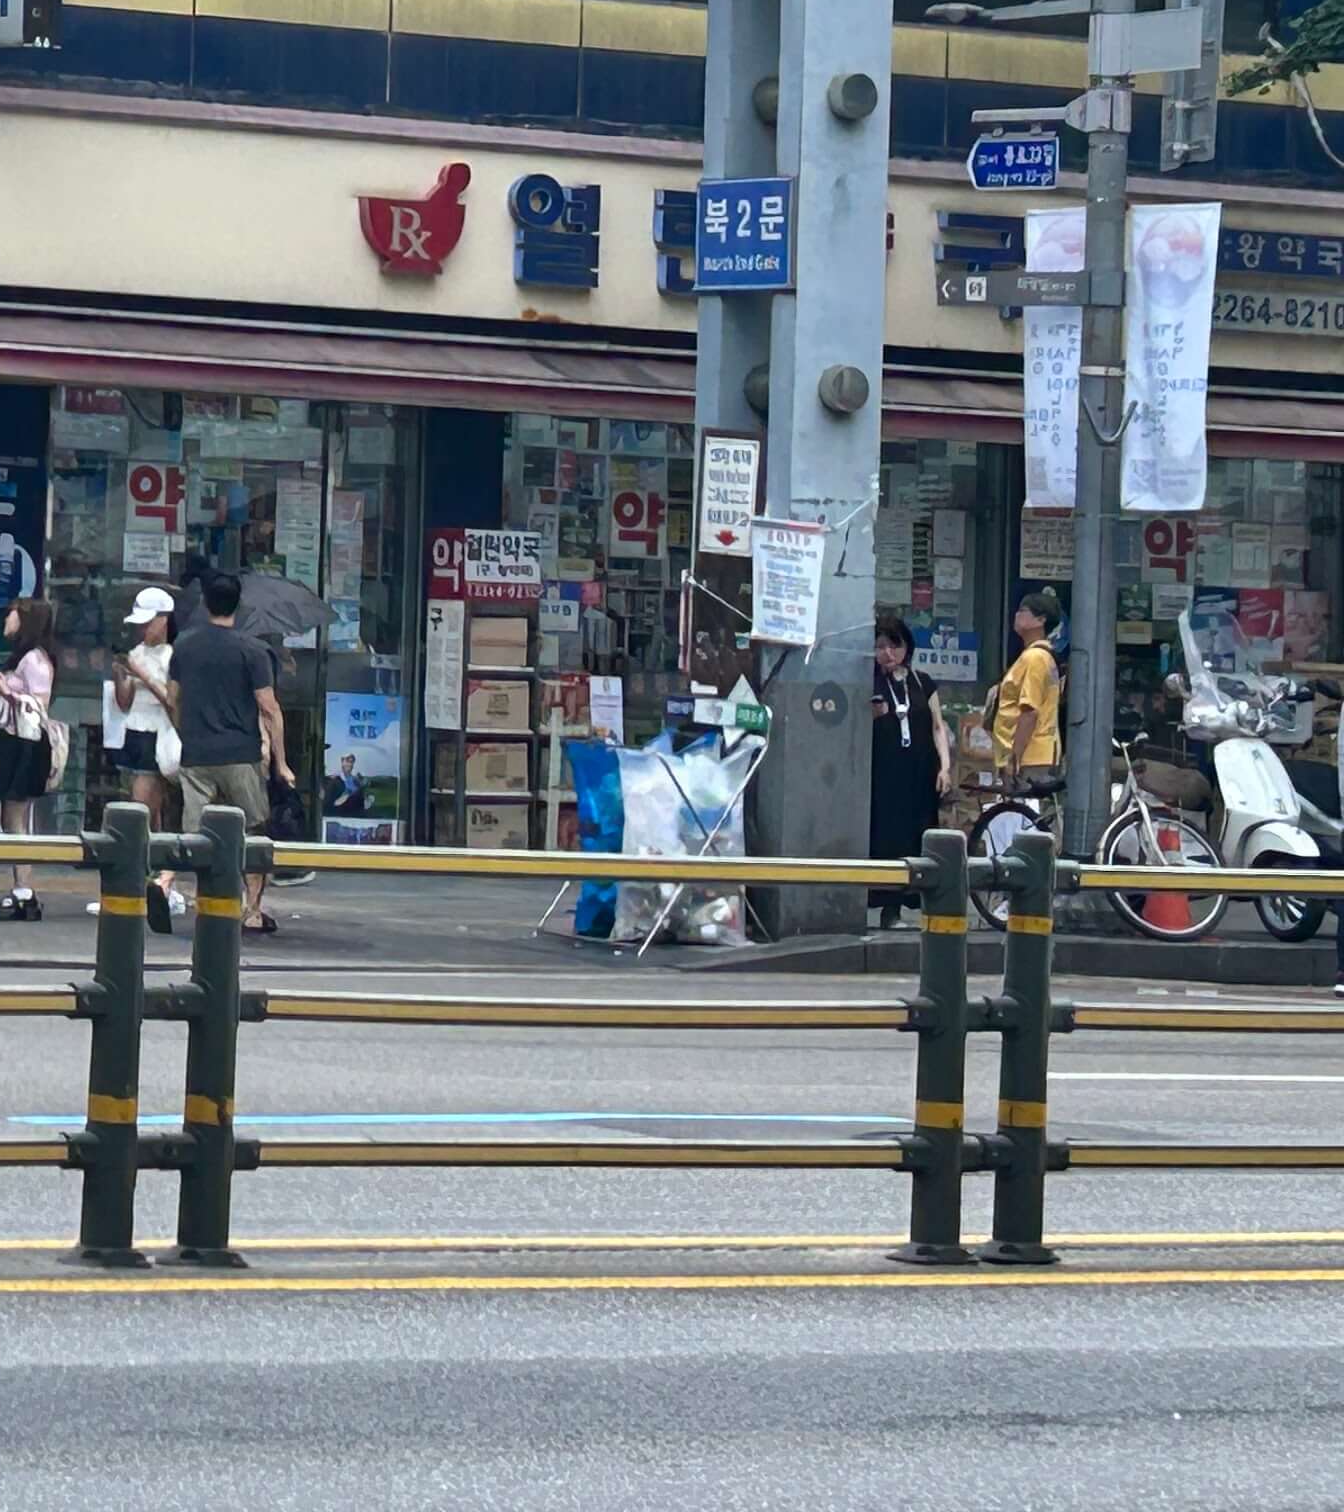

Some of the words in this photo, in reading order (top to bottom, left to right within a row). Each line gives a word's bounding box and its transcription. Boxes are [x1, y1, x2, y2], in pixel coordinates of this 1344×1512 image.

[1225, 232, 1343, 275] 왕약국
[129, 465, 185, 533] 약
[613, 491, 665, 557] 약
[1143, 518, 1196, 583] 약
